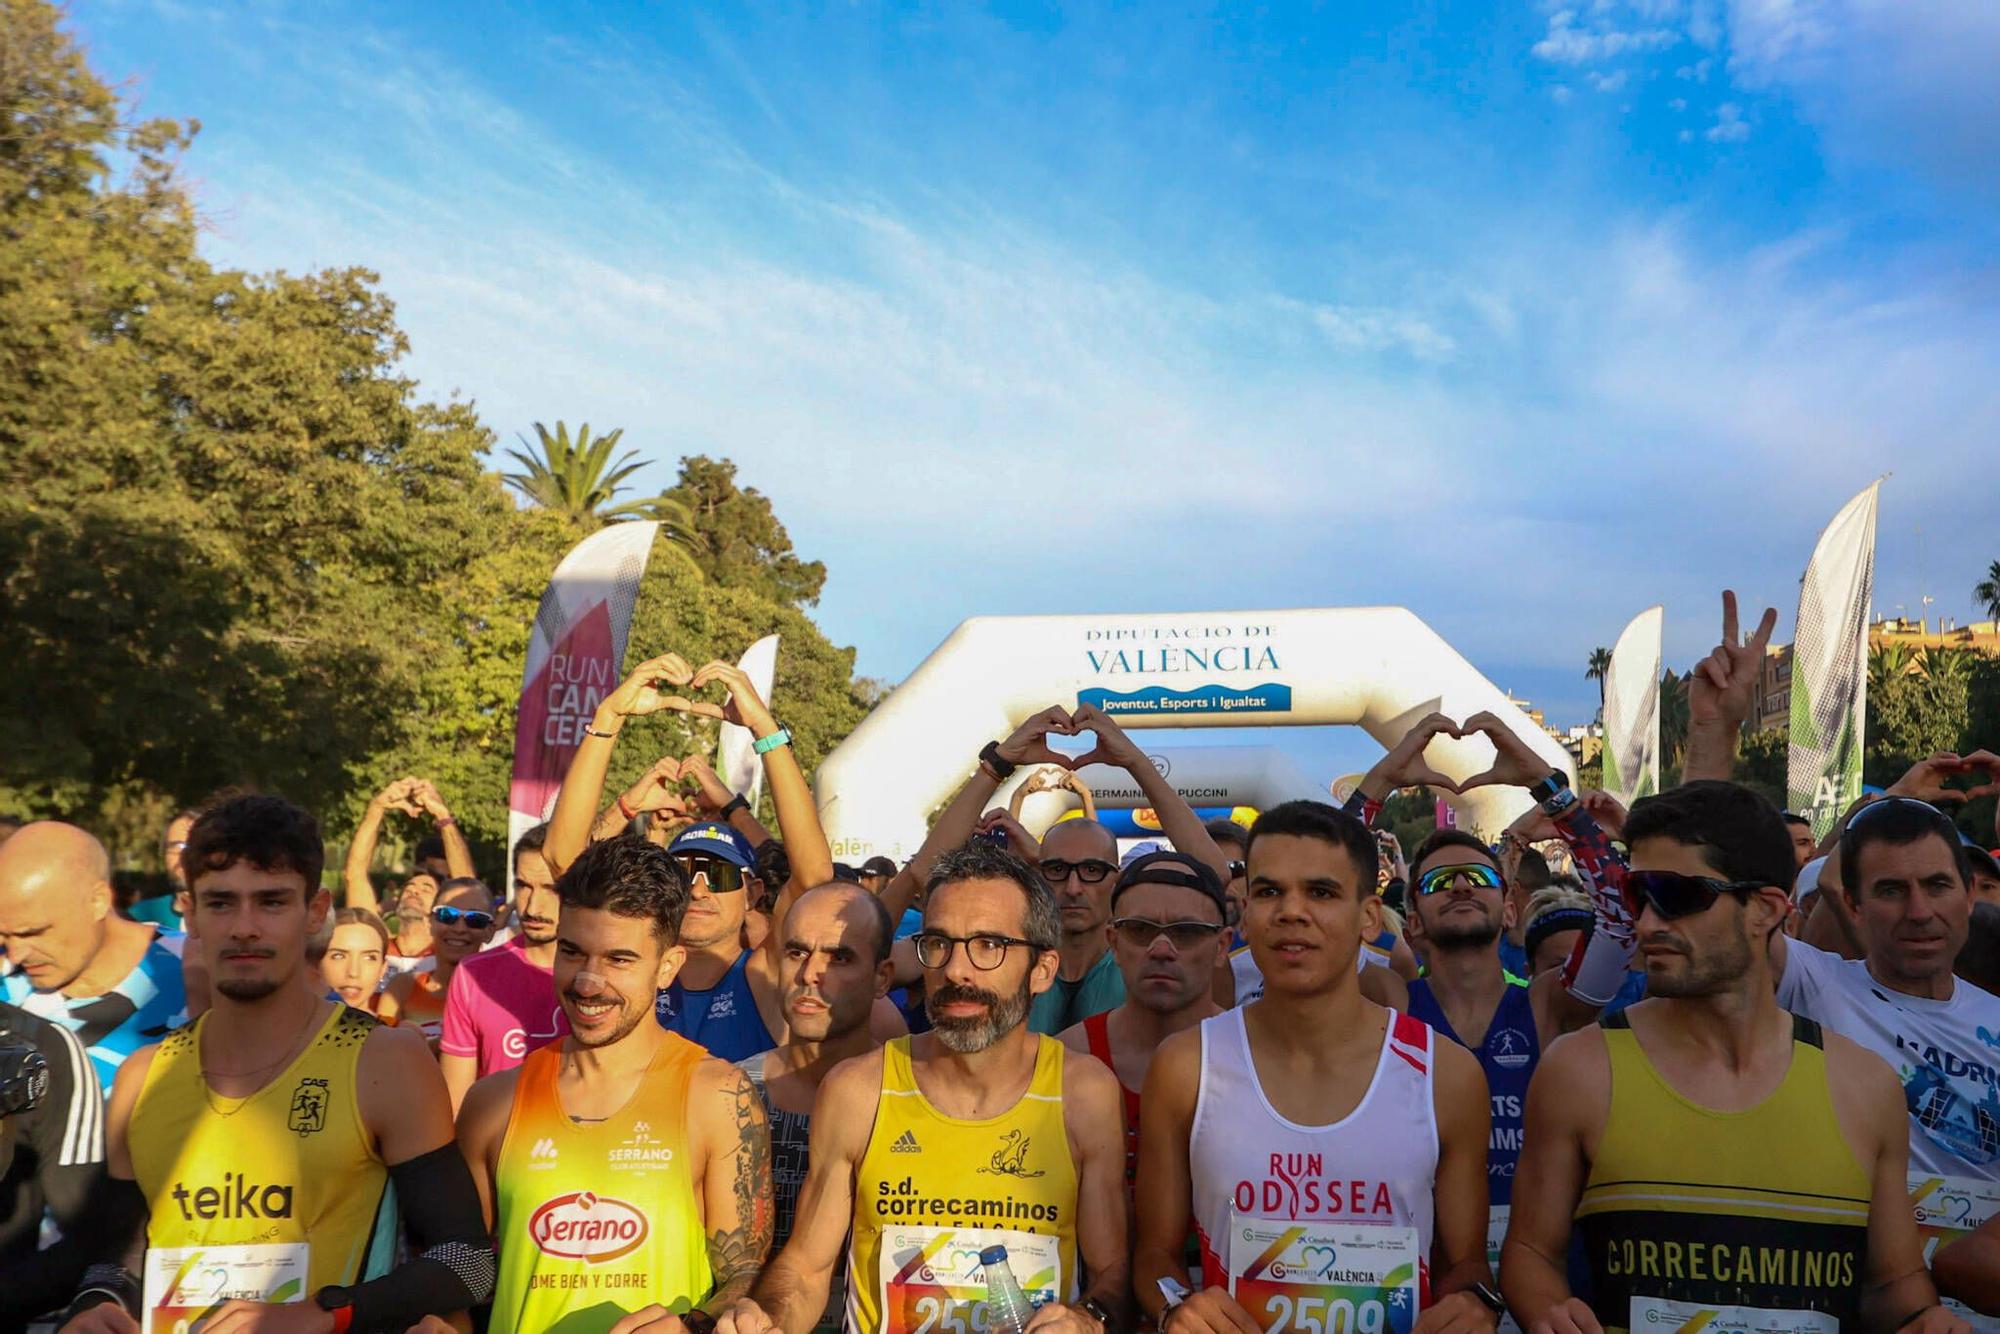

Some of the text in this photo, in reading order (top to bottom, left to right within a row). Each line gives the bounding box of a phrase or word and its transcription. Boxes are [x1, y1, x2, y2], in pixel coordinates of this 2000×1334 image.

[1245, 626, 1277, 637] DE
[550, 654, 609, 685] RUN
[1086, 644, 1280, 674] VALÈNCIA
[547, 684, 606, 715] CAN
[1102, 695, 1267, 711] Joventut, Esports i Igualtat
[1178, 788, 1228, 798] PUCCINI
[608, 1148, 673, 1162] SERRANO
[890, 1145, 922, 1153] adidas
[1270, 1153, 1322, 1177] RUN
[172, 1172, 293, 1221] teika
[879, 1176, 919, 1196] s.d.
[876, 1196, 1058, 1222] correcaminos
[1235, 1180, 1393, 1221] ODYSSEA
[540, 1212, 637, 1242] Serrano
[1327, 1268, 1374, 1284] VALÈNCIA
[1606, 1239, 1854, 1288] CORRECAMINOS
[531, 1273, 648, 1289] OME BIEN Y CORRE
[1266, 1294, 1385, 1334] 2509
